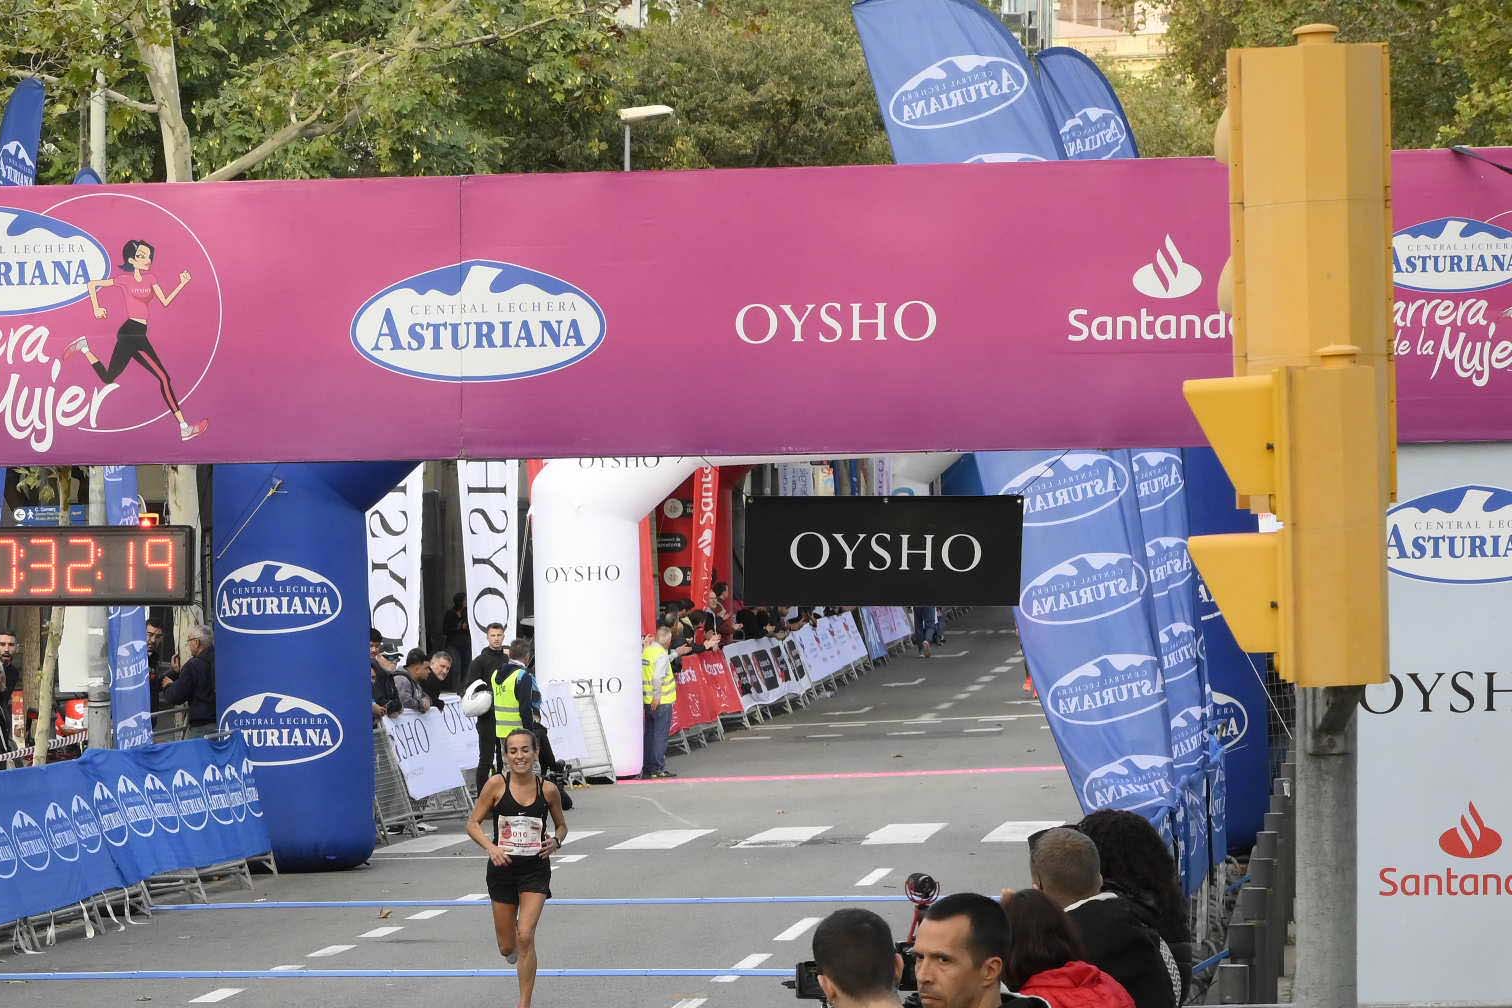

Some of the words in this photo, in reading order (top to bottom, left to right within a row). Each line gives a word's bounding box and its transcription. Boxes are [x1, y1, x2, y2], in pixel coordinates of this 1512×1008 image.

[13, 243, 86, 254] LECHERA
[1463, 242, 1512, 251] LECHER
[410, 303, 487, 316] CENTRAL
[496, 301, 578, 314] LECHERA
[735, 299, 938, 345] OYSHO
[1393, 298, 1488, 327] arrera
[371, 307, 586, 352] ASTURIANA
[1067, 308, 1234, 342] Santand
[1416, 327, 1435, 355] la
[1430, 322, 1512, 387] Muje
[1413, 519, 1482, 530] CENTRAL
[790, 531, 982, 573] OYSHO
[545, 565, 620, 584] OYSHO
[220, 590, 333, 618] ASTURIANA
[232, 586, 275, 595] CENTRAL
[279, 585, 328, 594] LECHERA
[233, 717, 275, 726] CENTRAL
[279, 716, 329, 725] LECHERA
[538, 696, 568, 729] SHO
[223, 722, 334, 747] ATURIANA
[391, 717, 431, 762] SHO
